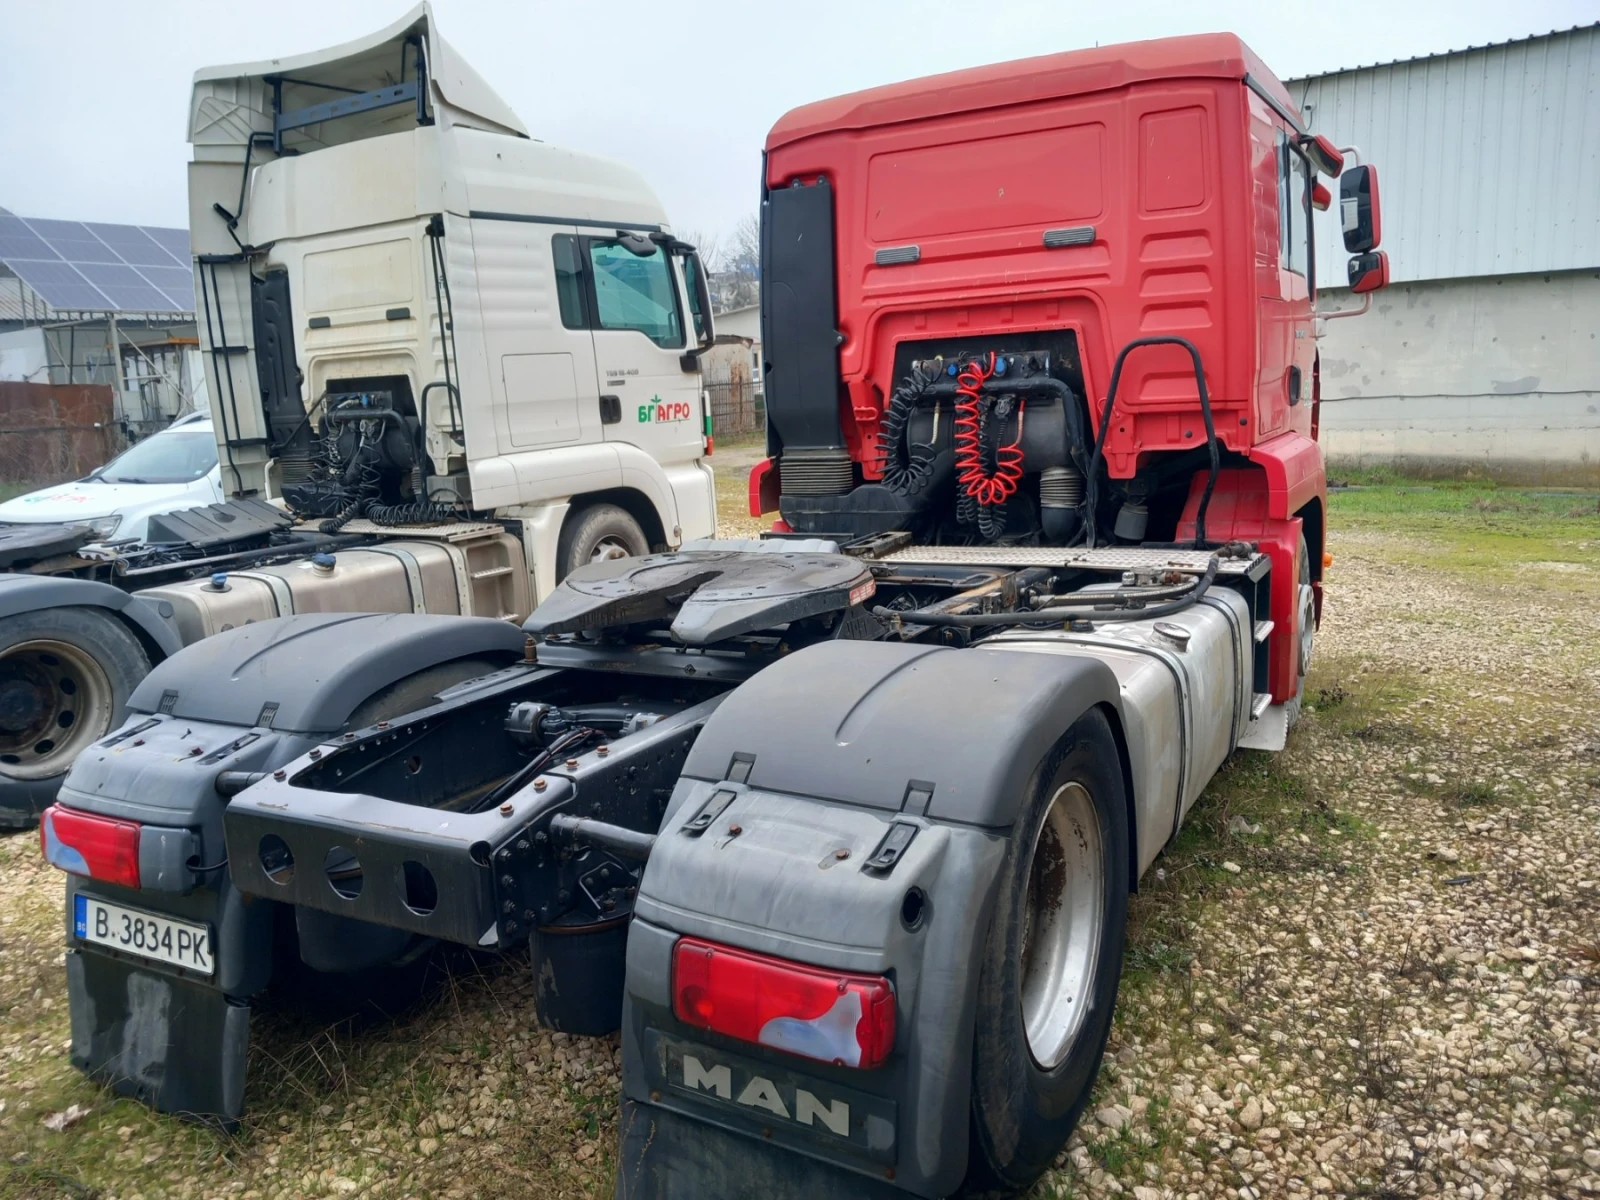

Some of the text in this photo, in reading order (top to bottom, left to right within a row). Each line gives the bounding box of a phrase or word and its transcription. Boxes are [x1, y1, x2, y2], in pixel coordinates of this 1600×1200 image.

[657, 402, 690, 421] АГРО
[77, 921, 86, 932] BG
[683, 1054, 849, 1137] MAN
